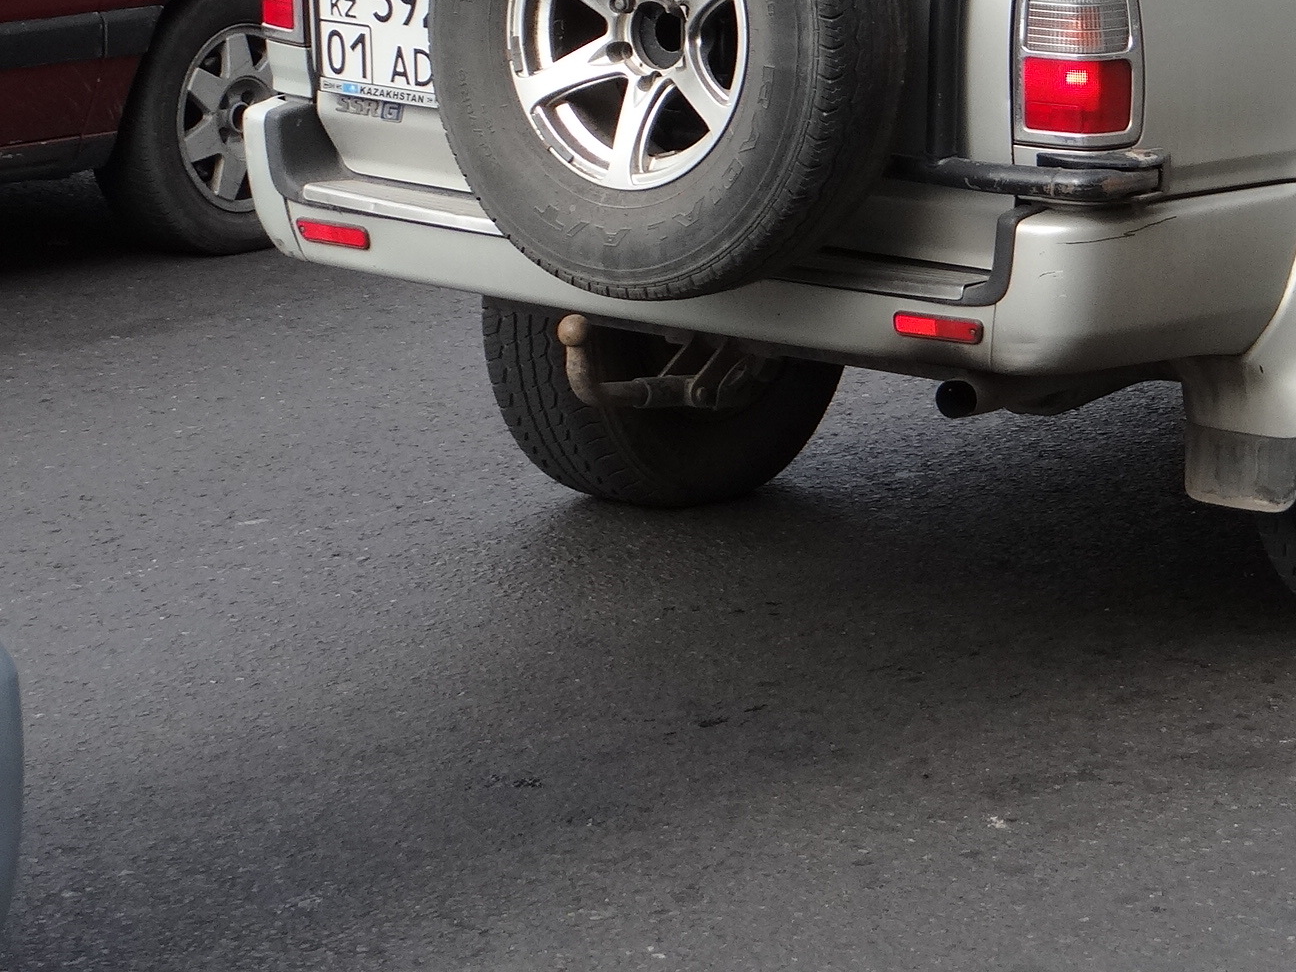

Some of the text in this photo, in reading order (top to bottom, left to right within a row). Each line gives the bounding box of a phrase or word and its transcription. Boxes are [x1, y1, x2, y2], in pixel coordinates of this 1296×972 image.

[327, 29, 433, 87] 01 AD
[359, 85, 426, 104] KAZAKHSTAN
